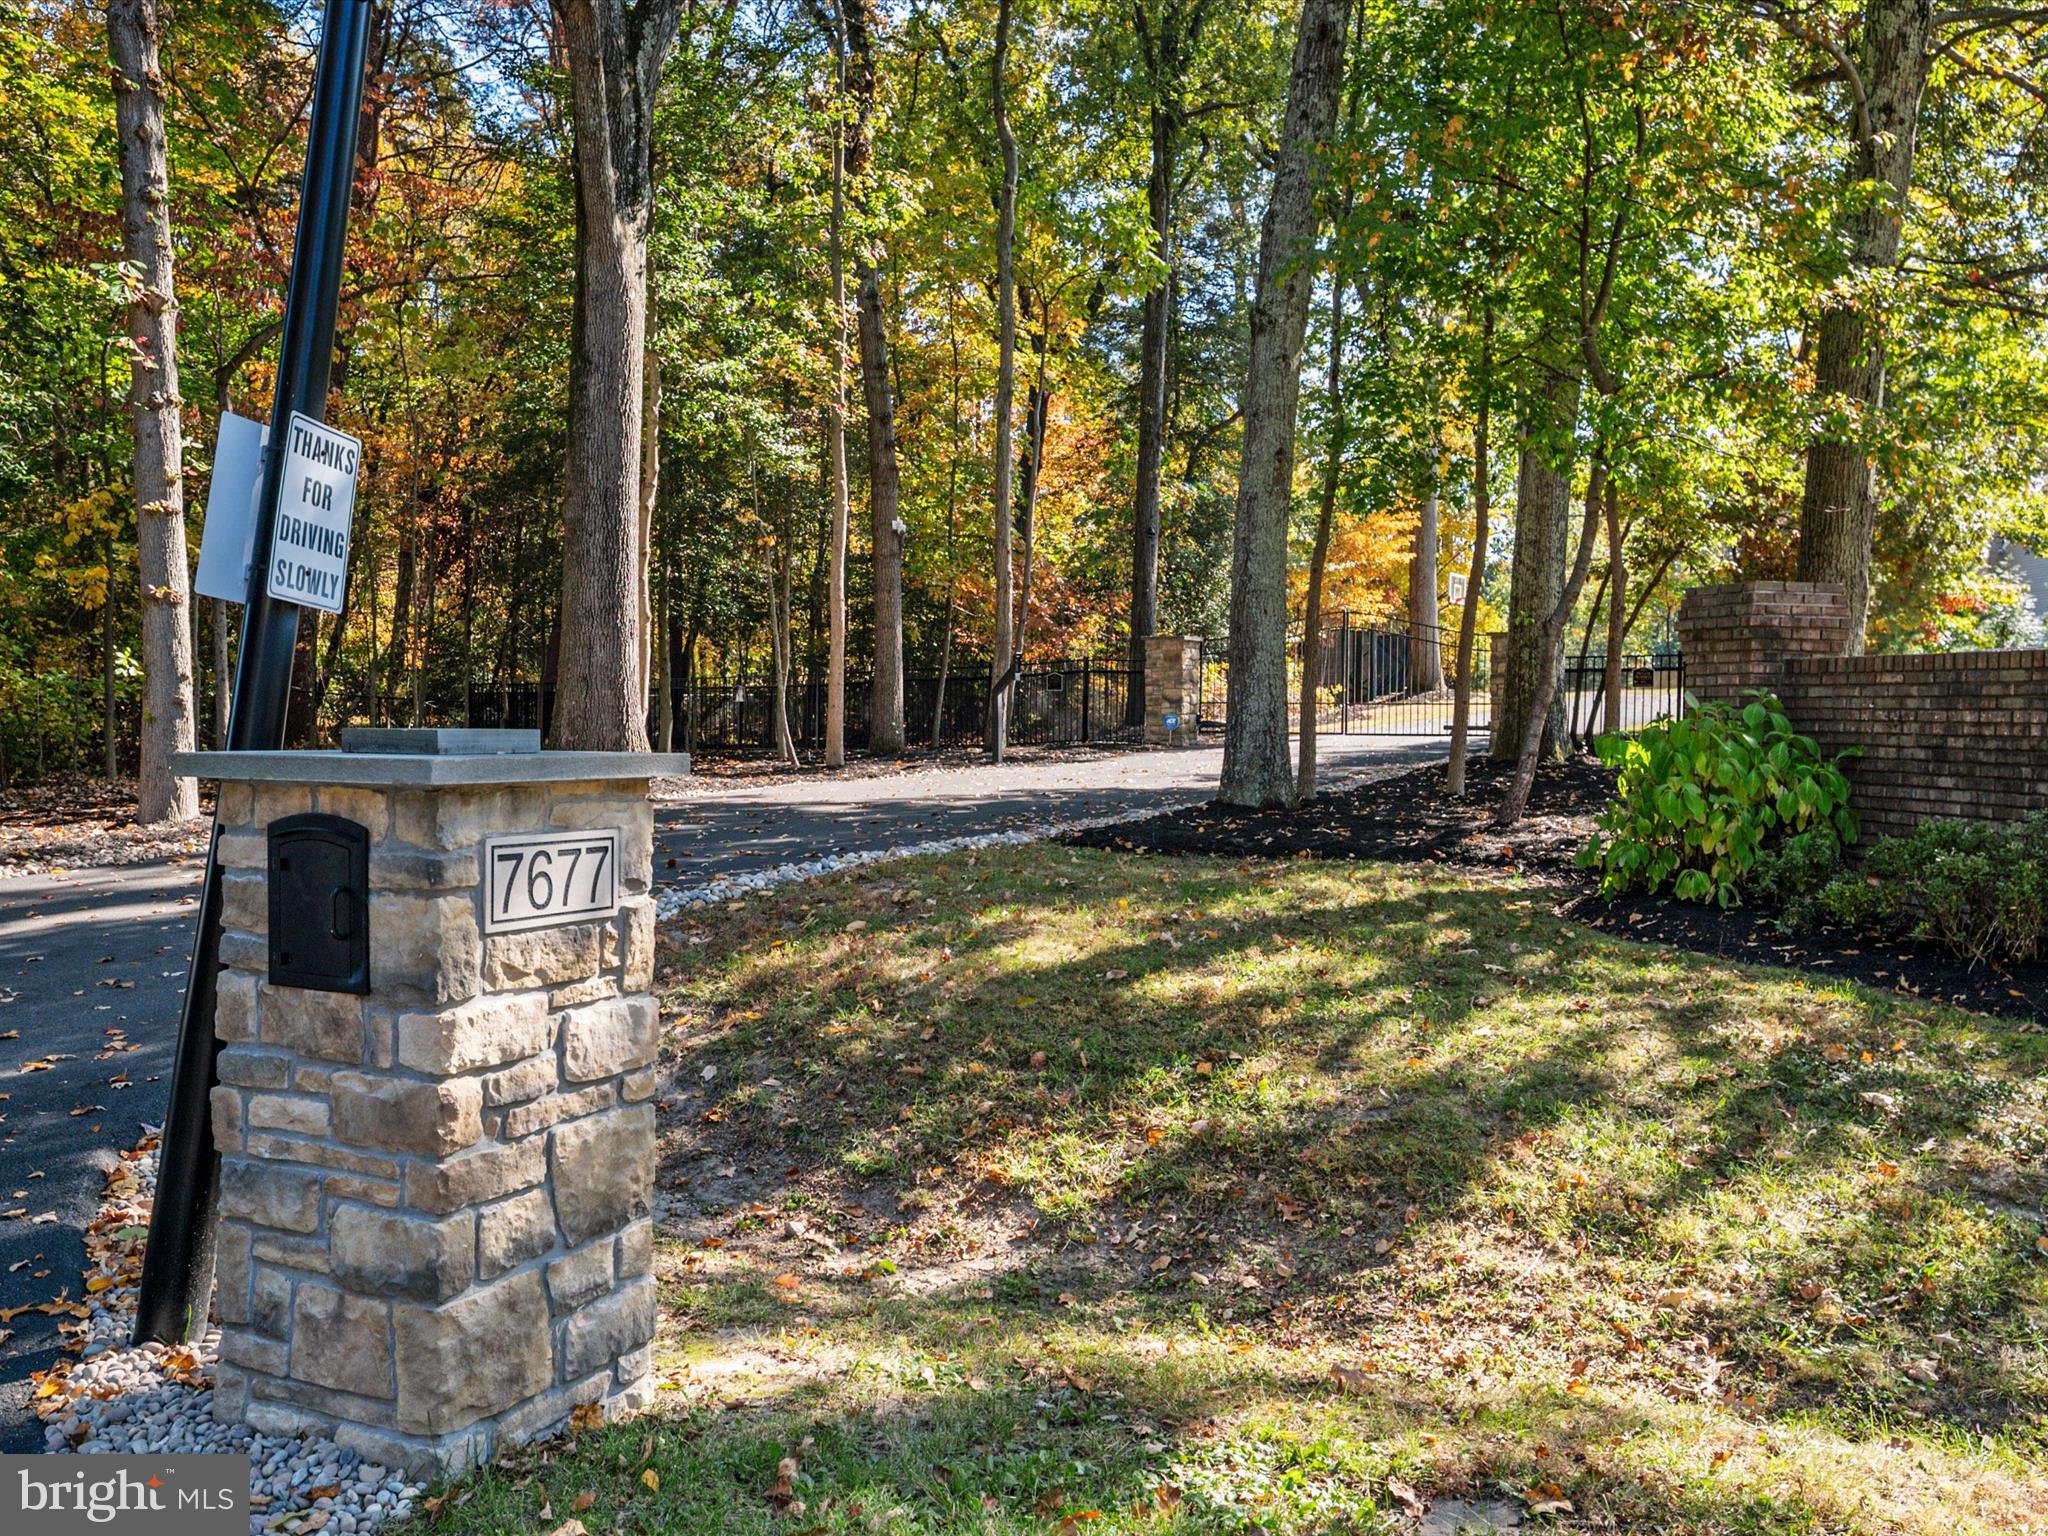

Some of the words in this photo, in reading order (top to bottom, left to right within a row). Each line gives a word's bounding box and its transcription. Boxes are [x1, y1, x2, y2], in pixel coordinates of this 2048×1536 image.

[293, 425, 356, 475] THANKS
[302, 476, 333, 511] FOR
[279, 513, 345, 559] DRIVING
[275, 558, 340, 600] SLOWLY
[497, 846, 609, 914] 7677
